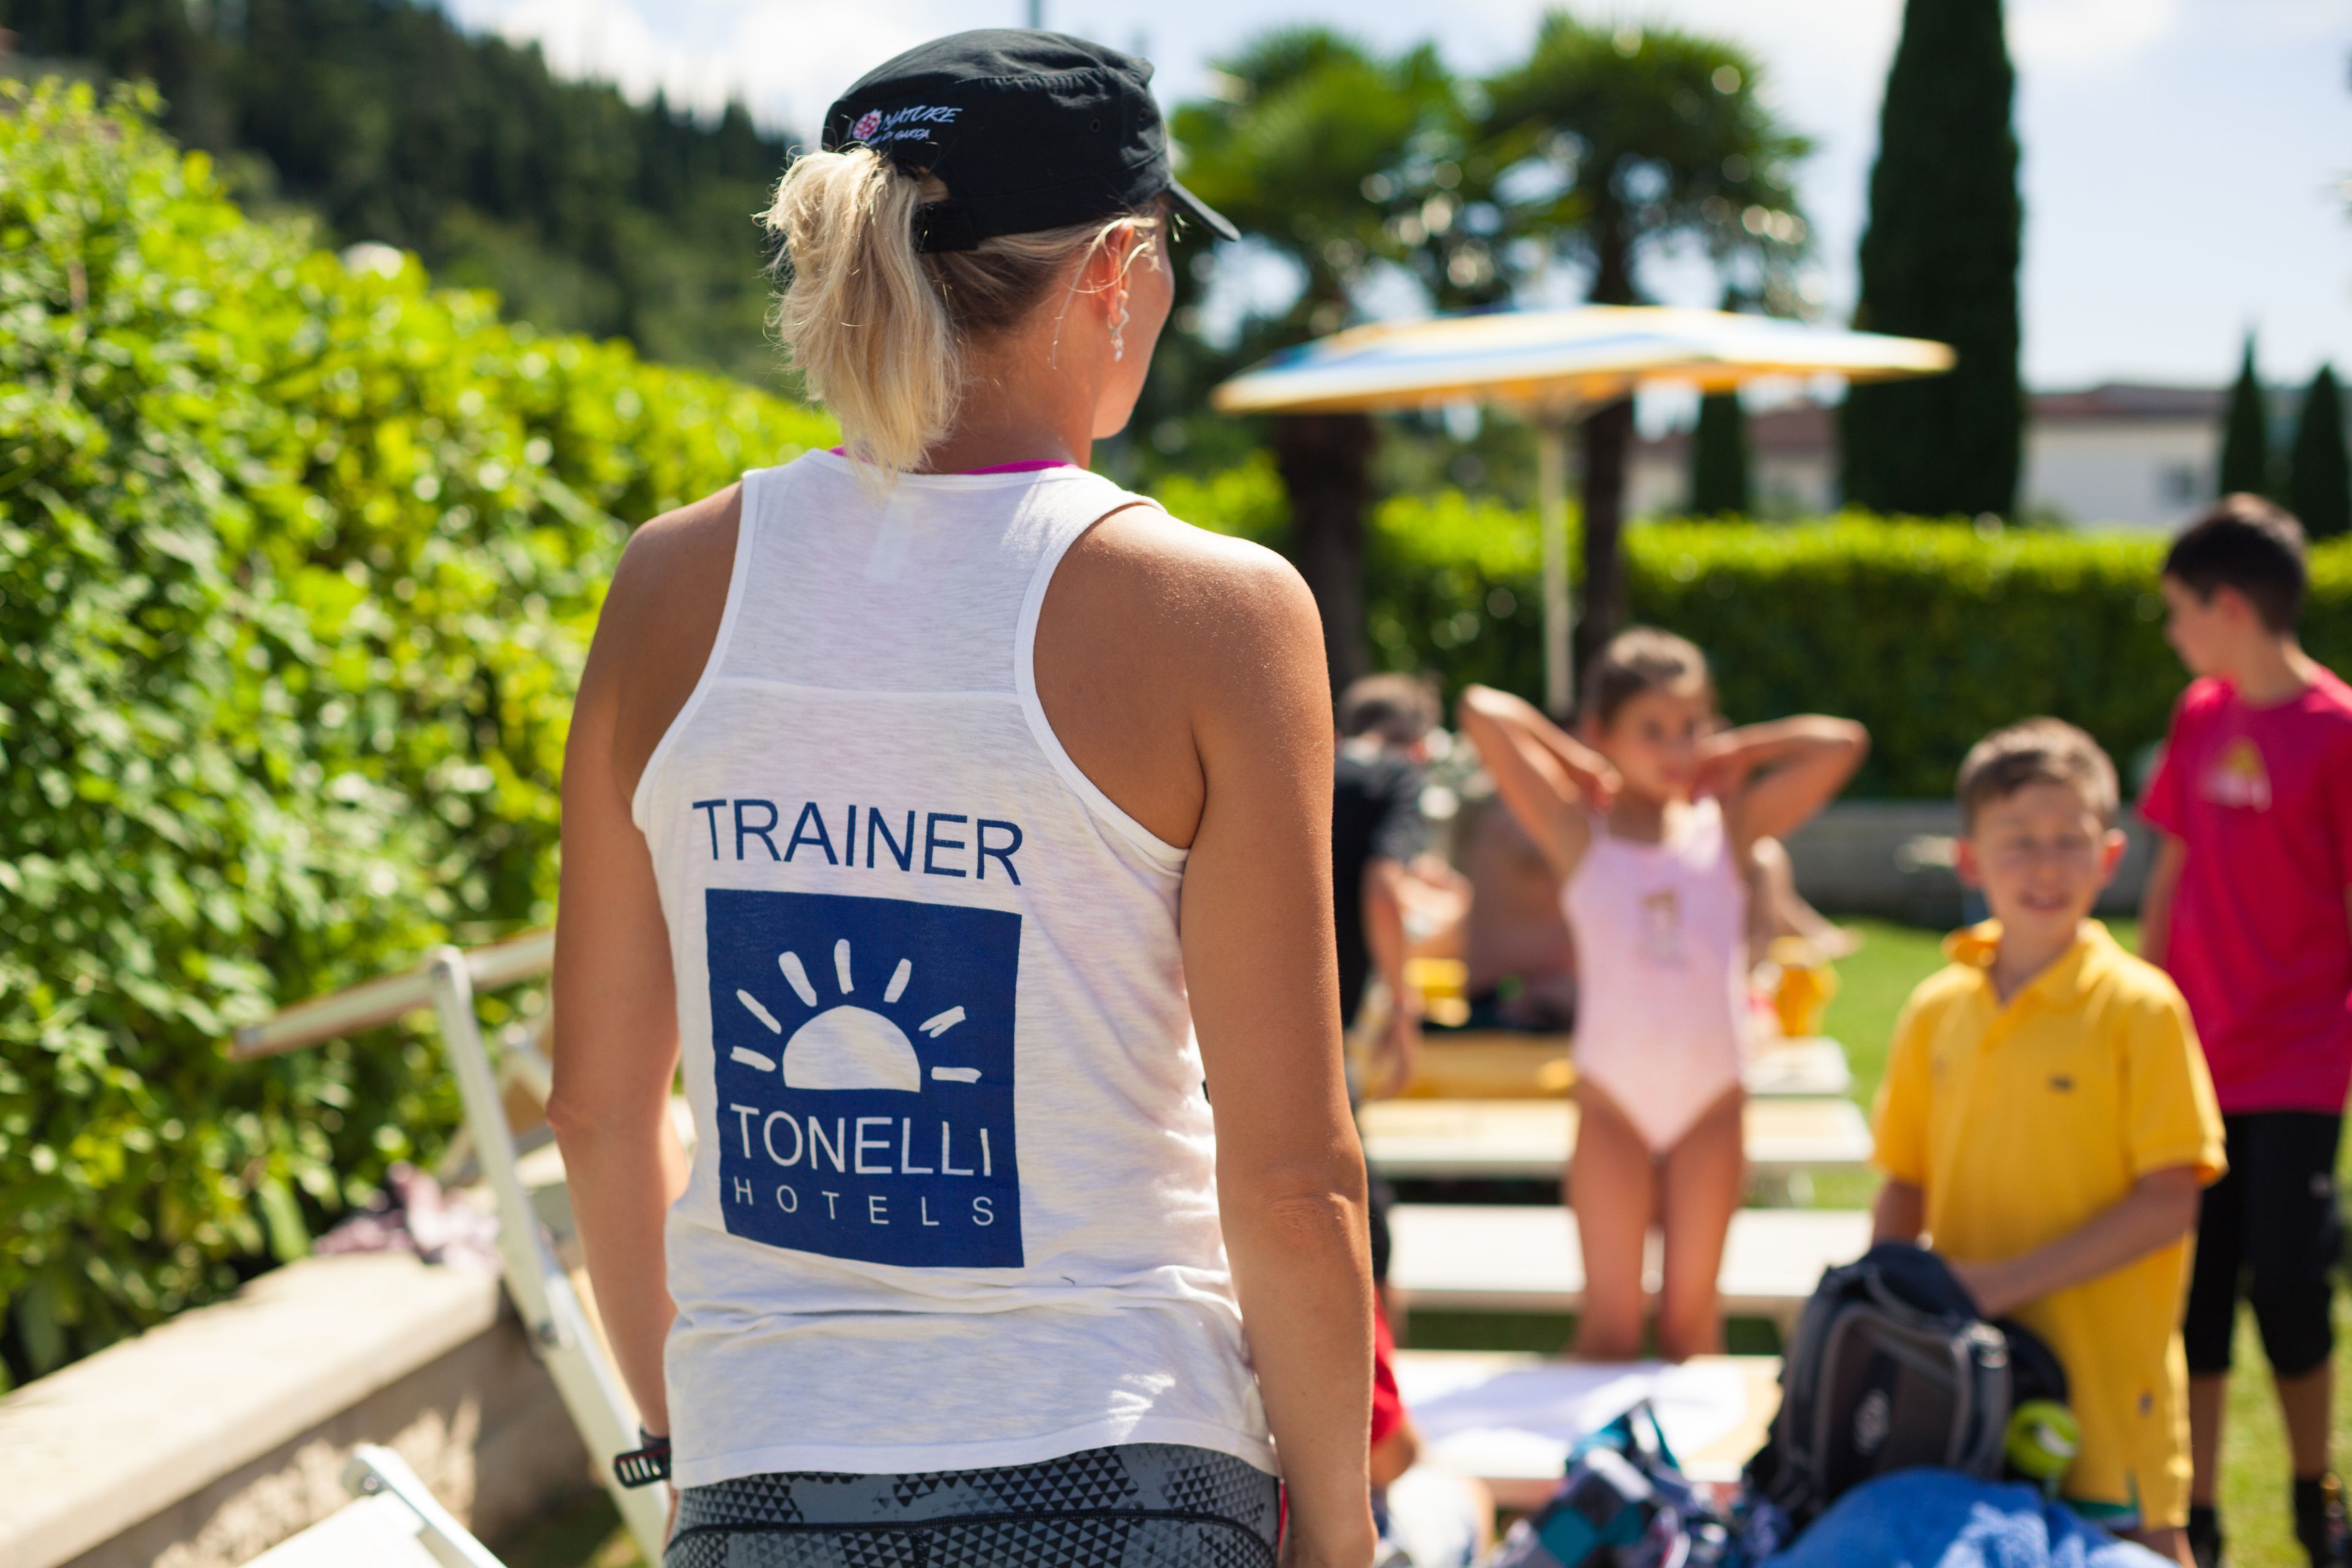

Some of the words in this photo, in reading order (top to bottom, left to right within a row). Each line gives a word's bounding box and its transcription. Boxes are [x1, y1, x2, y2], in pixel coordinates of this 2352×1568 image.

[880, 105, 963, 130] NATURE
[692, 799, 1023, 886] TRAINER
[730, 1103, 992, 1177] TONELLI
[734, 1176, 994, 1226] HOTELS
